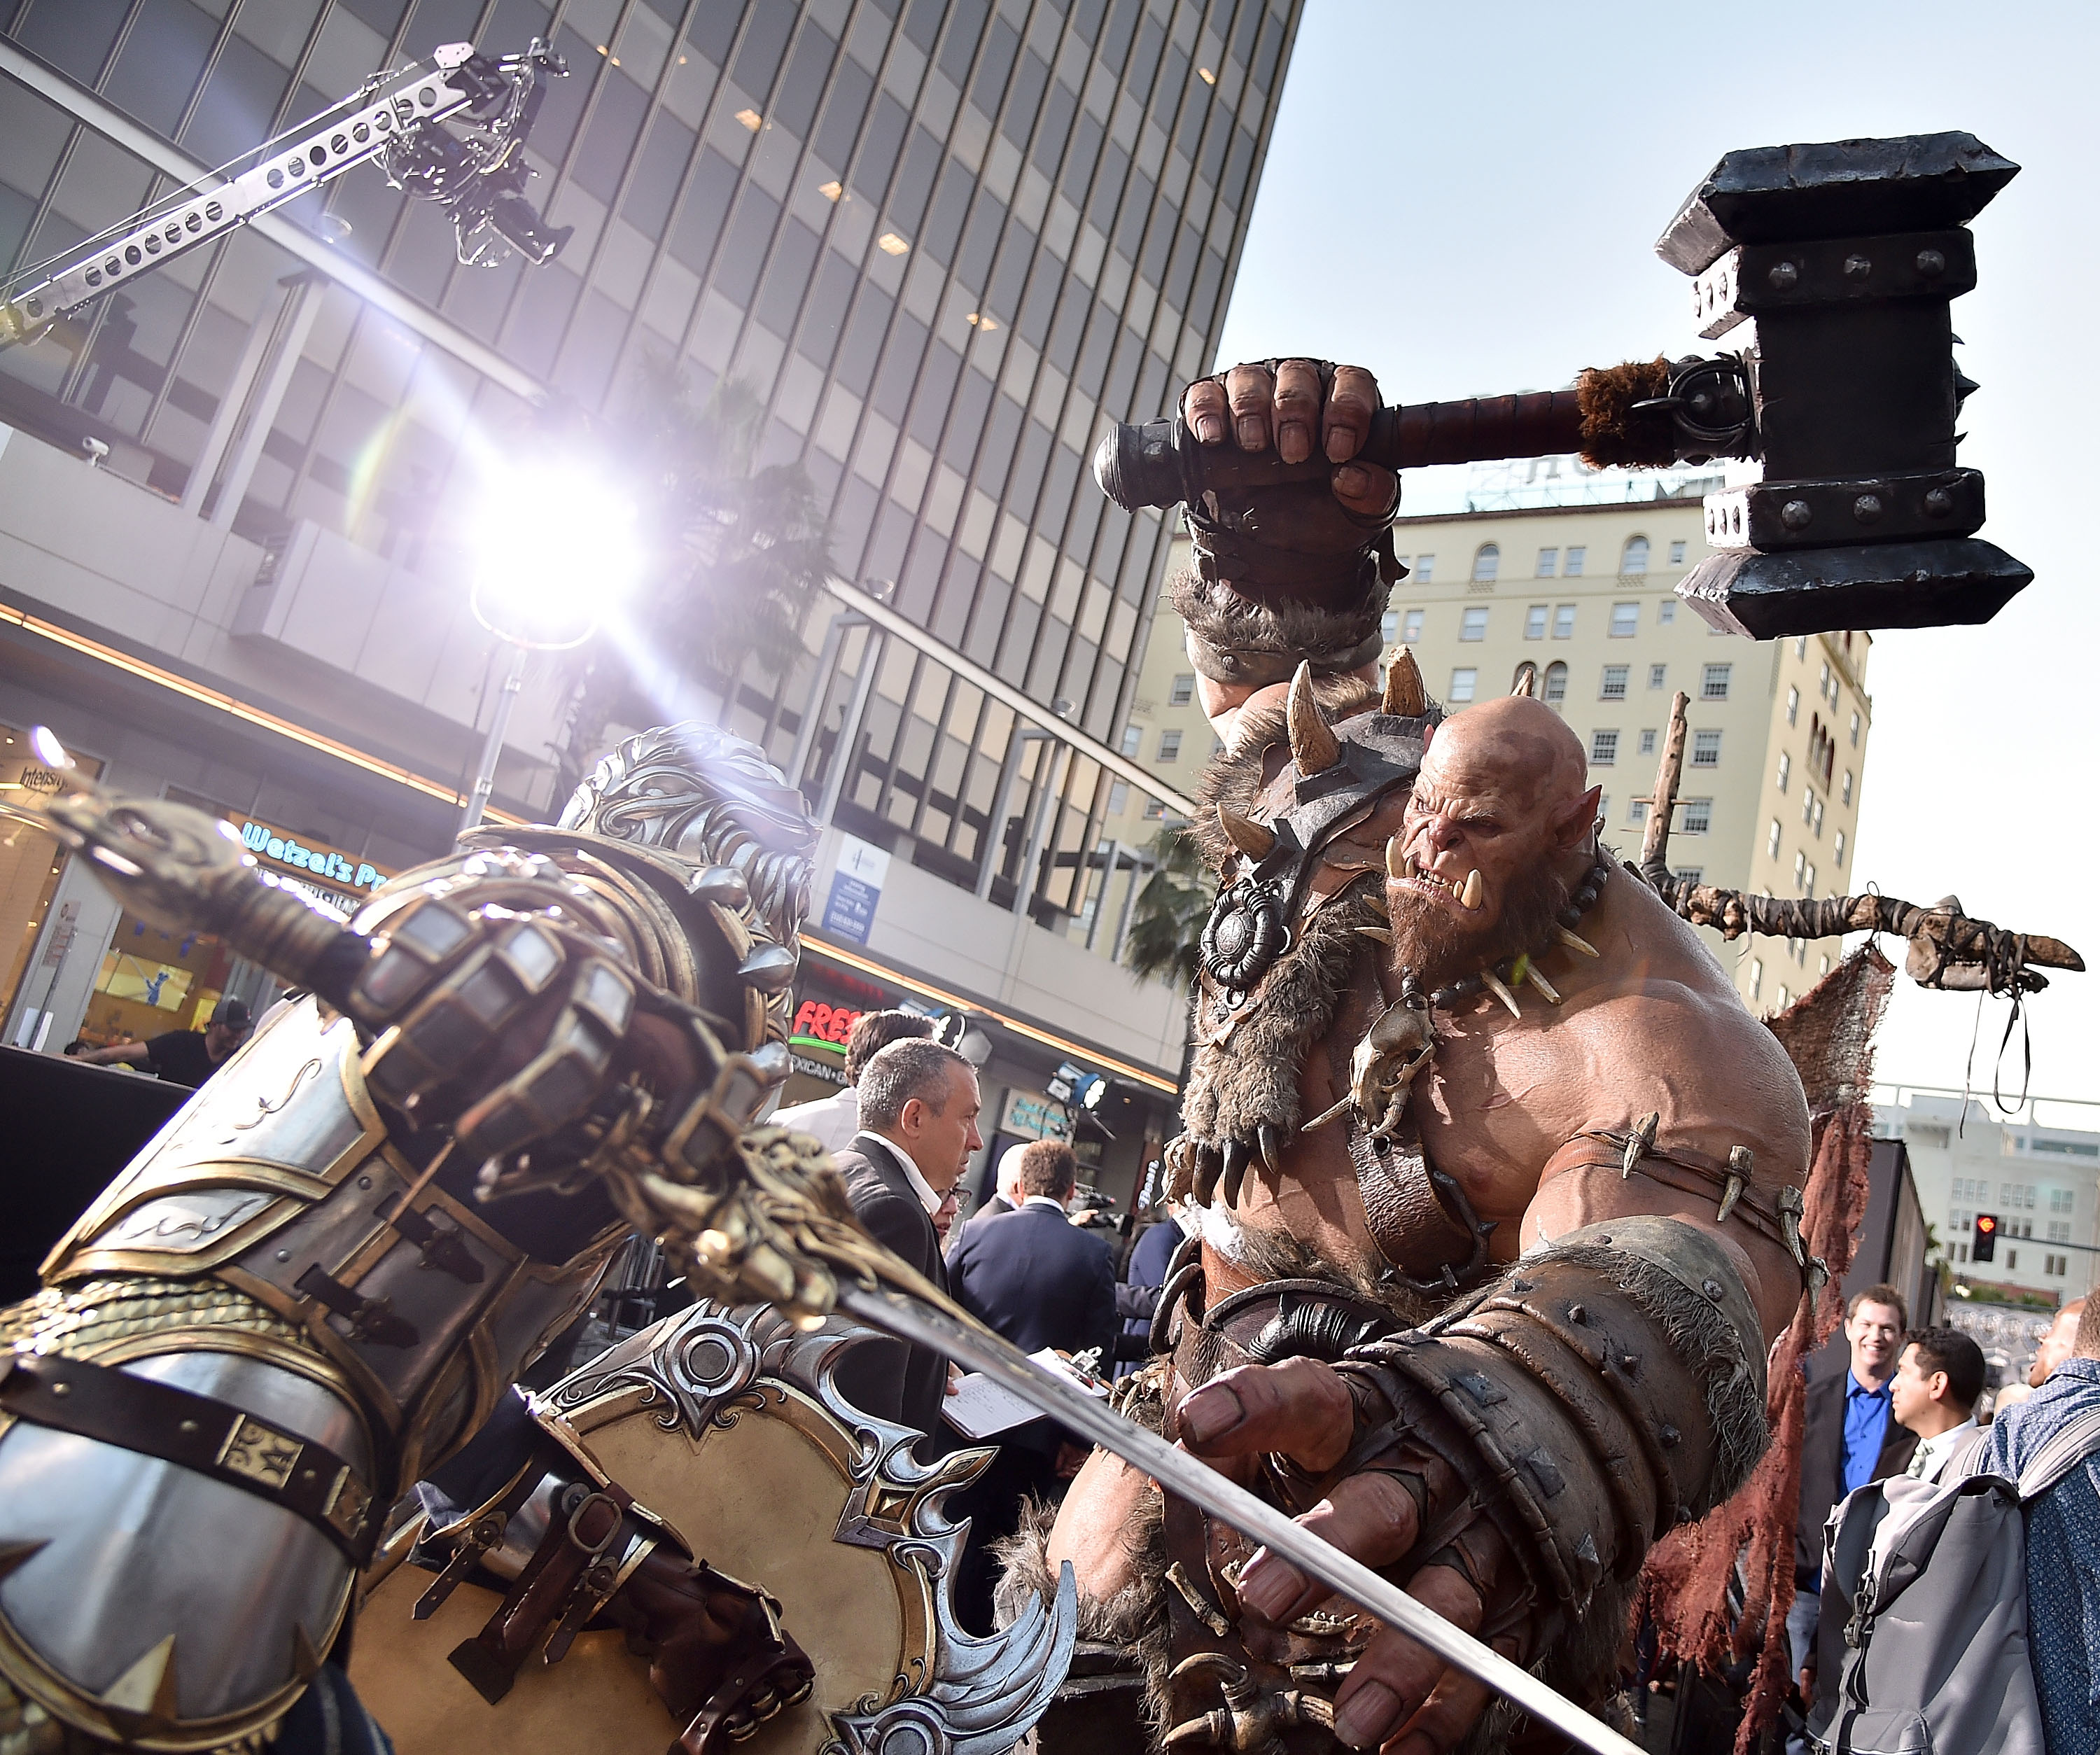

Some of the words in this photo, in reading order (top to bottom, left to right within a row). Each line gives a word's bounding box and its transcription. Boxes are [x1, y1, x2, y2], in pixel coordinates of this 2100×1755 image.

[241, 821, 354, 883] Wetzel's
[354, 862, 387, 892] Pr
[792, 1000, 862, 1044] FRES
